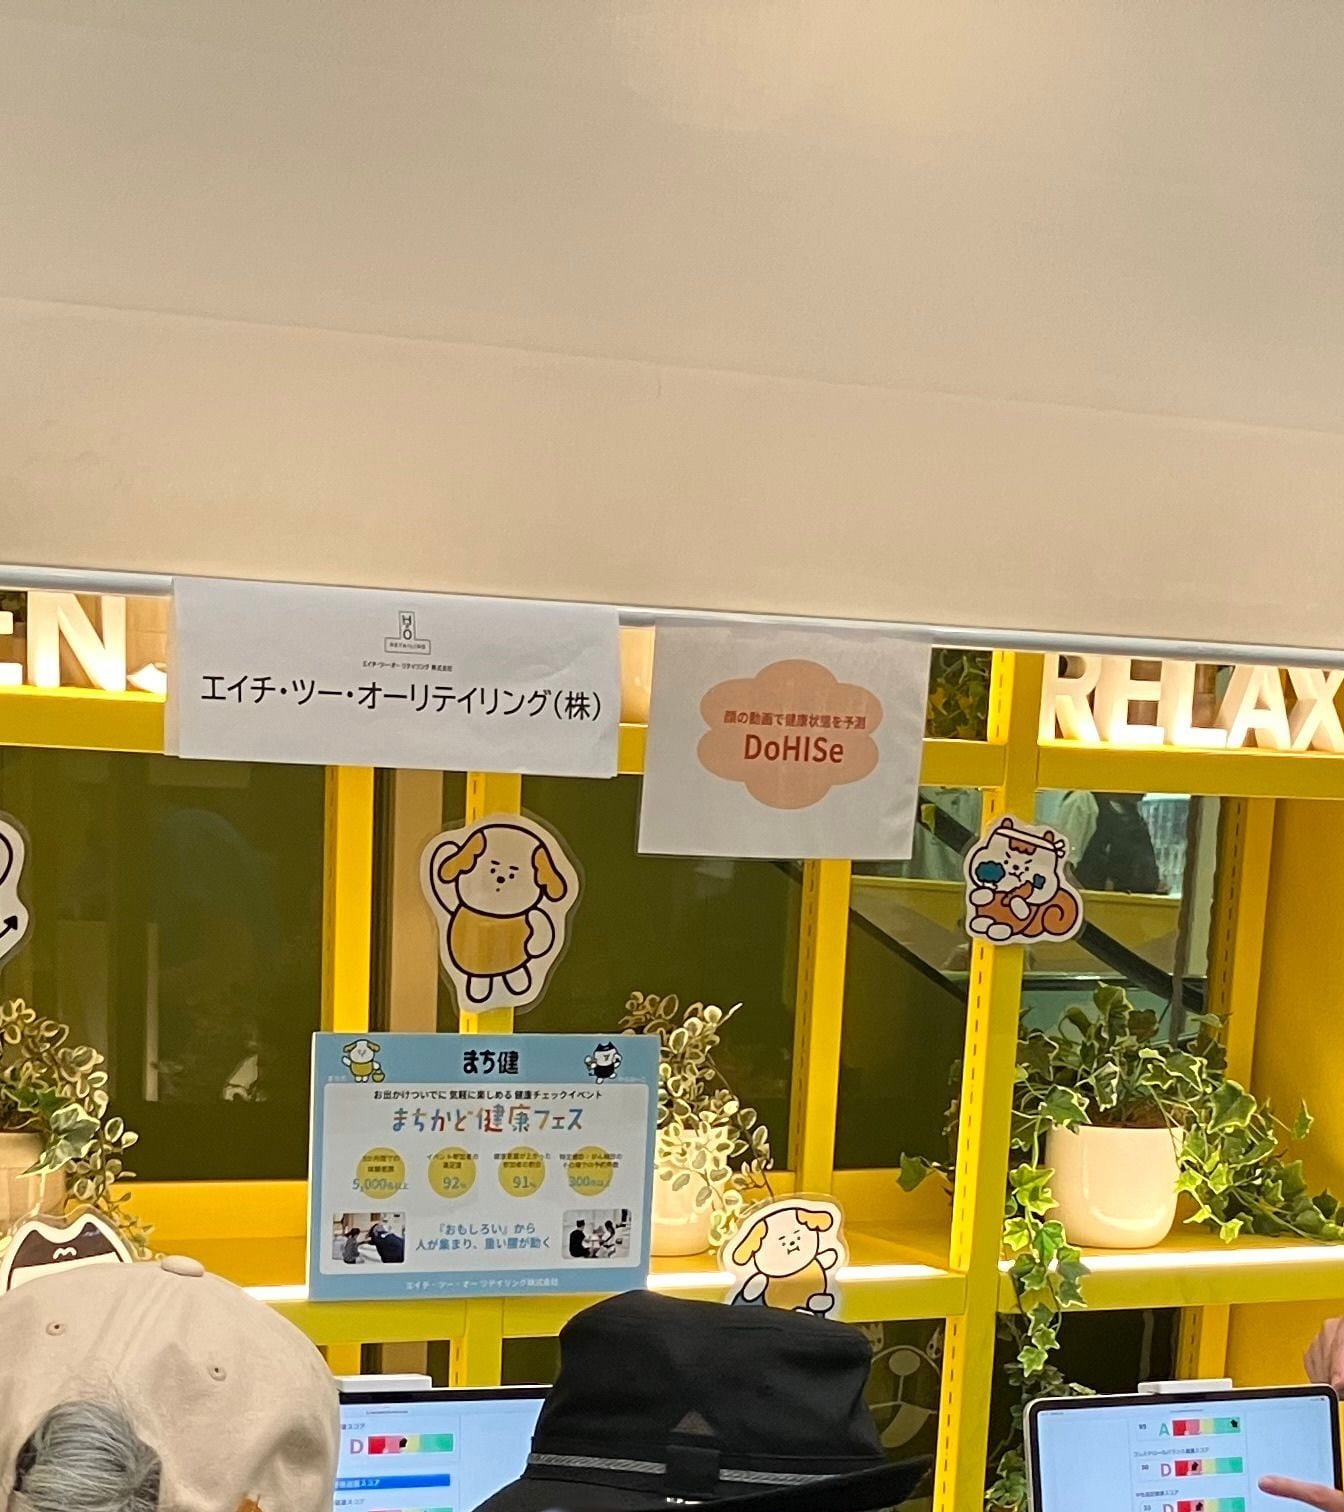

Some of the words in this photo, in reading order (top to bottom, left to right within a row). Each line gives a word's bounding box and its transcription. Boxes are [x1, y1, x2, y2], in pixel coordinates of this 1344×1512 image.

[744, 733, 844, 763] DoHISe
[463, 1050, 519, 1075] まち健
[392, 1104, 584, 1133] まちかど健康フェス
[1159, 1423, 1170, 1436] A
[350, 1439, 364, 1454] D
[1161, 1463, 1172, 1477] D
